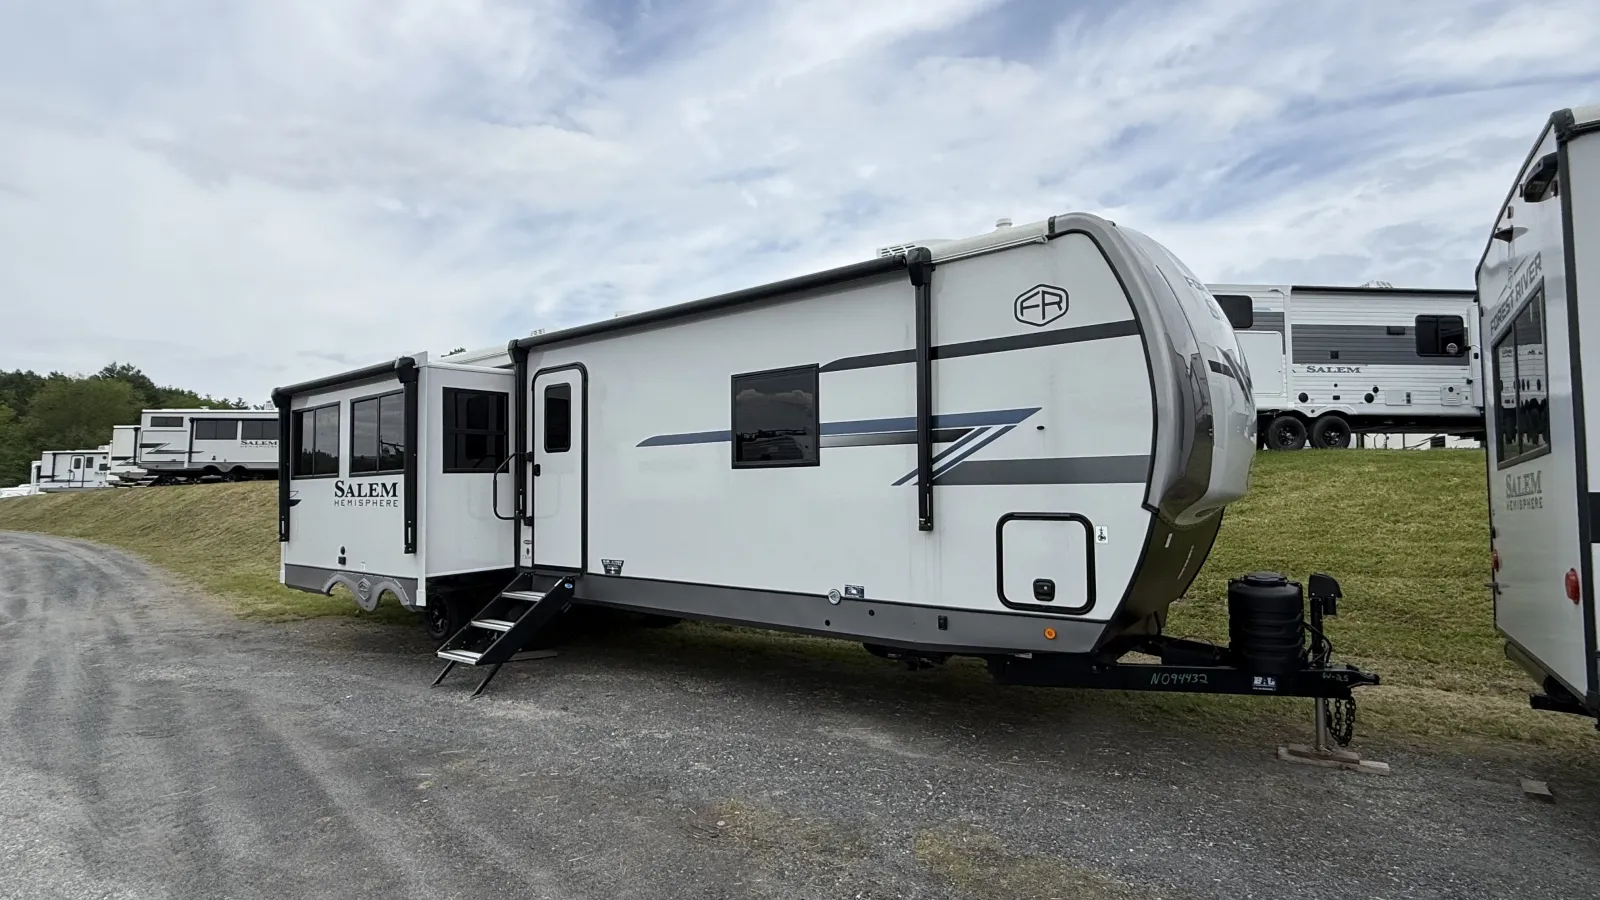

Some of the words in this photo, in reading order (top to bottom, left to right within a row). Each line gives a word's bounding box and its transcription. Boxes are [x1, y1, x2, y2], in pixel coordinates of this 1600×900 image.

[1490, 289, 1514, 336] FOREST
[1515, 251, 1542, 302] RIVER
[1020, 290, 1063, 321] FR
[1306, 365, 1361, 373] SALEM
[334, 480, 399, 498] SALEM
[1506, 470, 1542, 498] SALEM
[334, 499, 399, 508] HEMISPHERE
